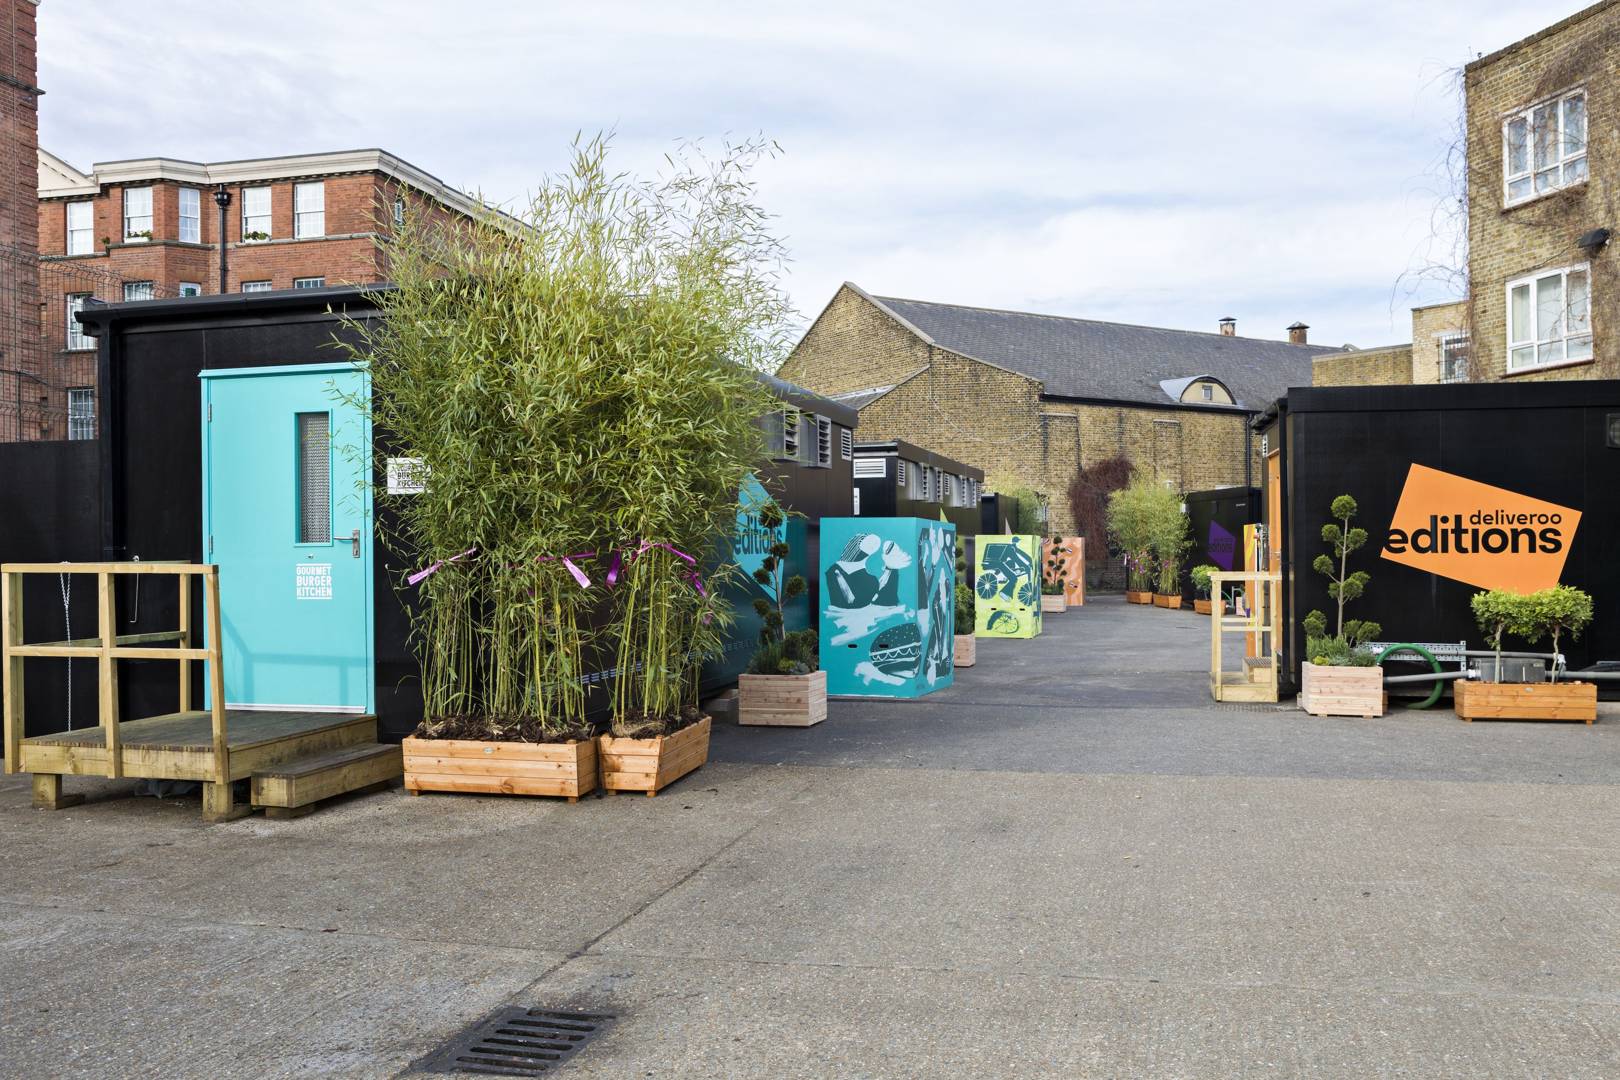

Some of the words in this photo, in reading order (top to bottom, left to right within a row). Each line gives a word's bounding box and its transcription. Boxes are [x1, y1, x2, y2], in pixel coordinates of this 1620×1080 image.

[1469, 510, 1562, 525] deliveroo
[1383, 514, 1562, 554] editions
[296, 566, 332, 576] GOURMET
[296, 576, 332, 587] BURGER
[296, 587, 333, 597] KITCHEN
